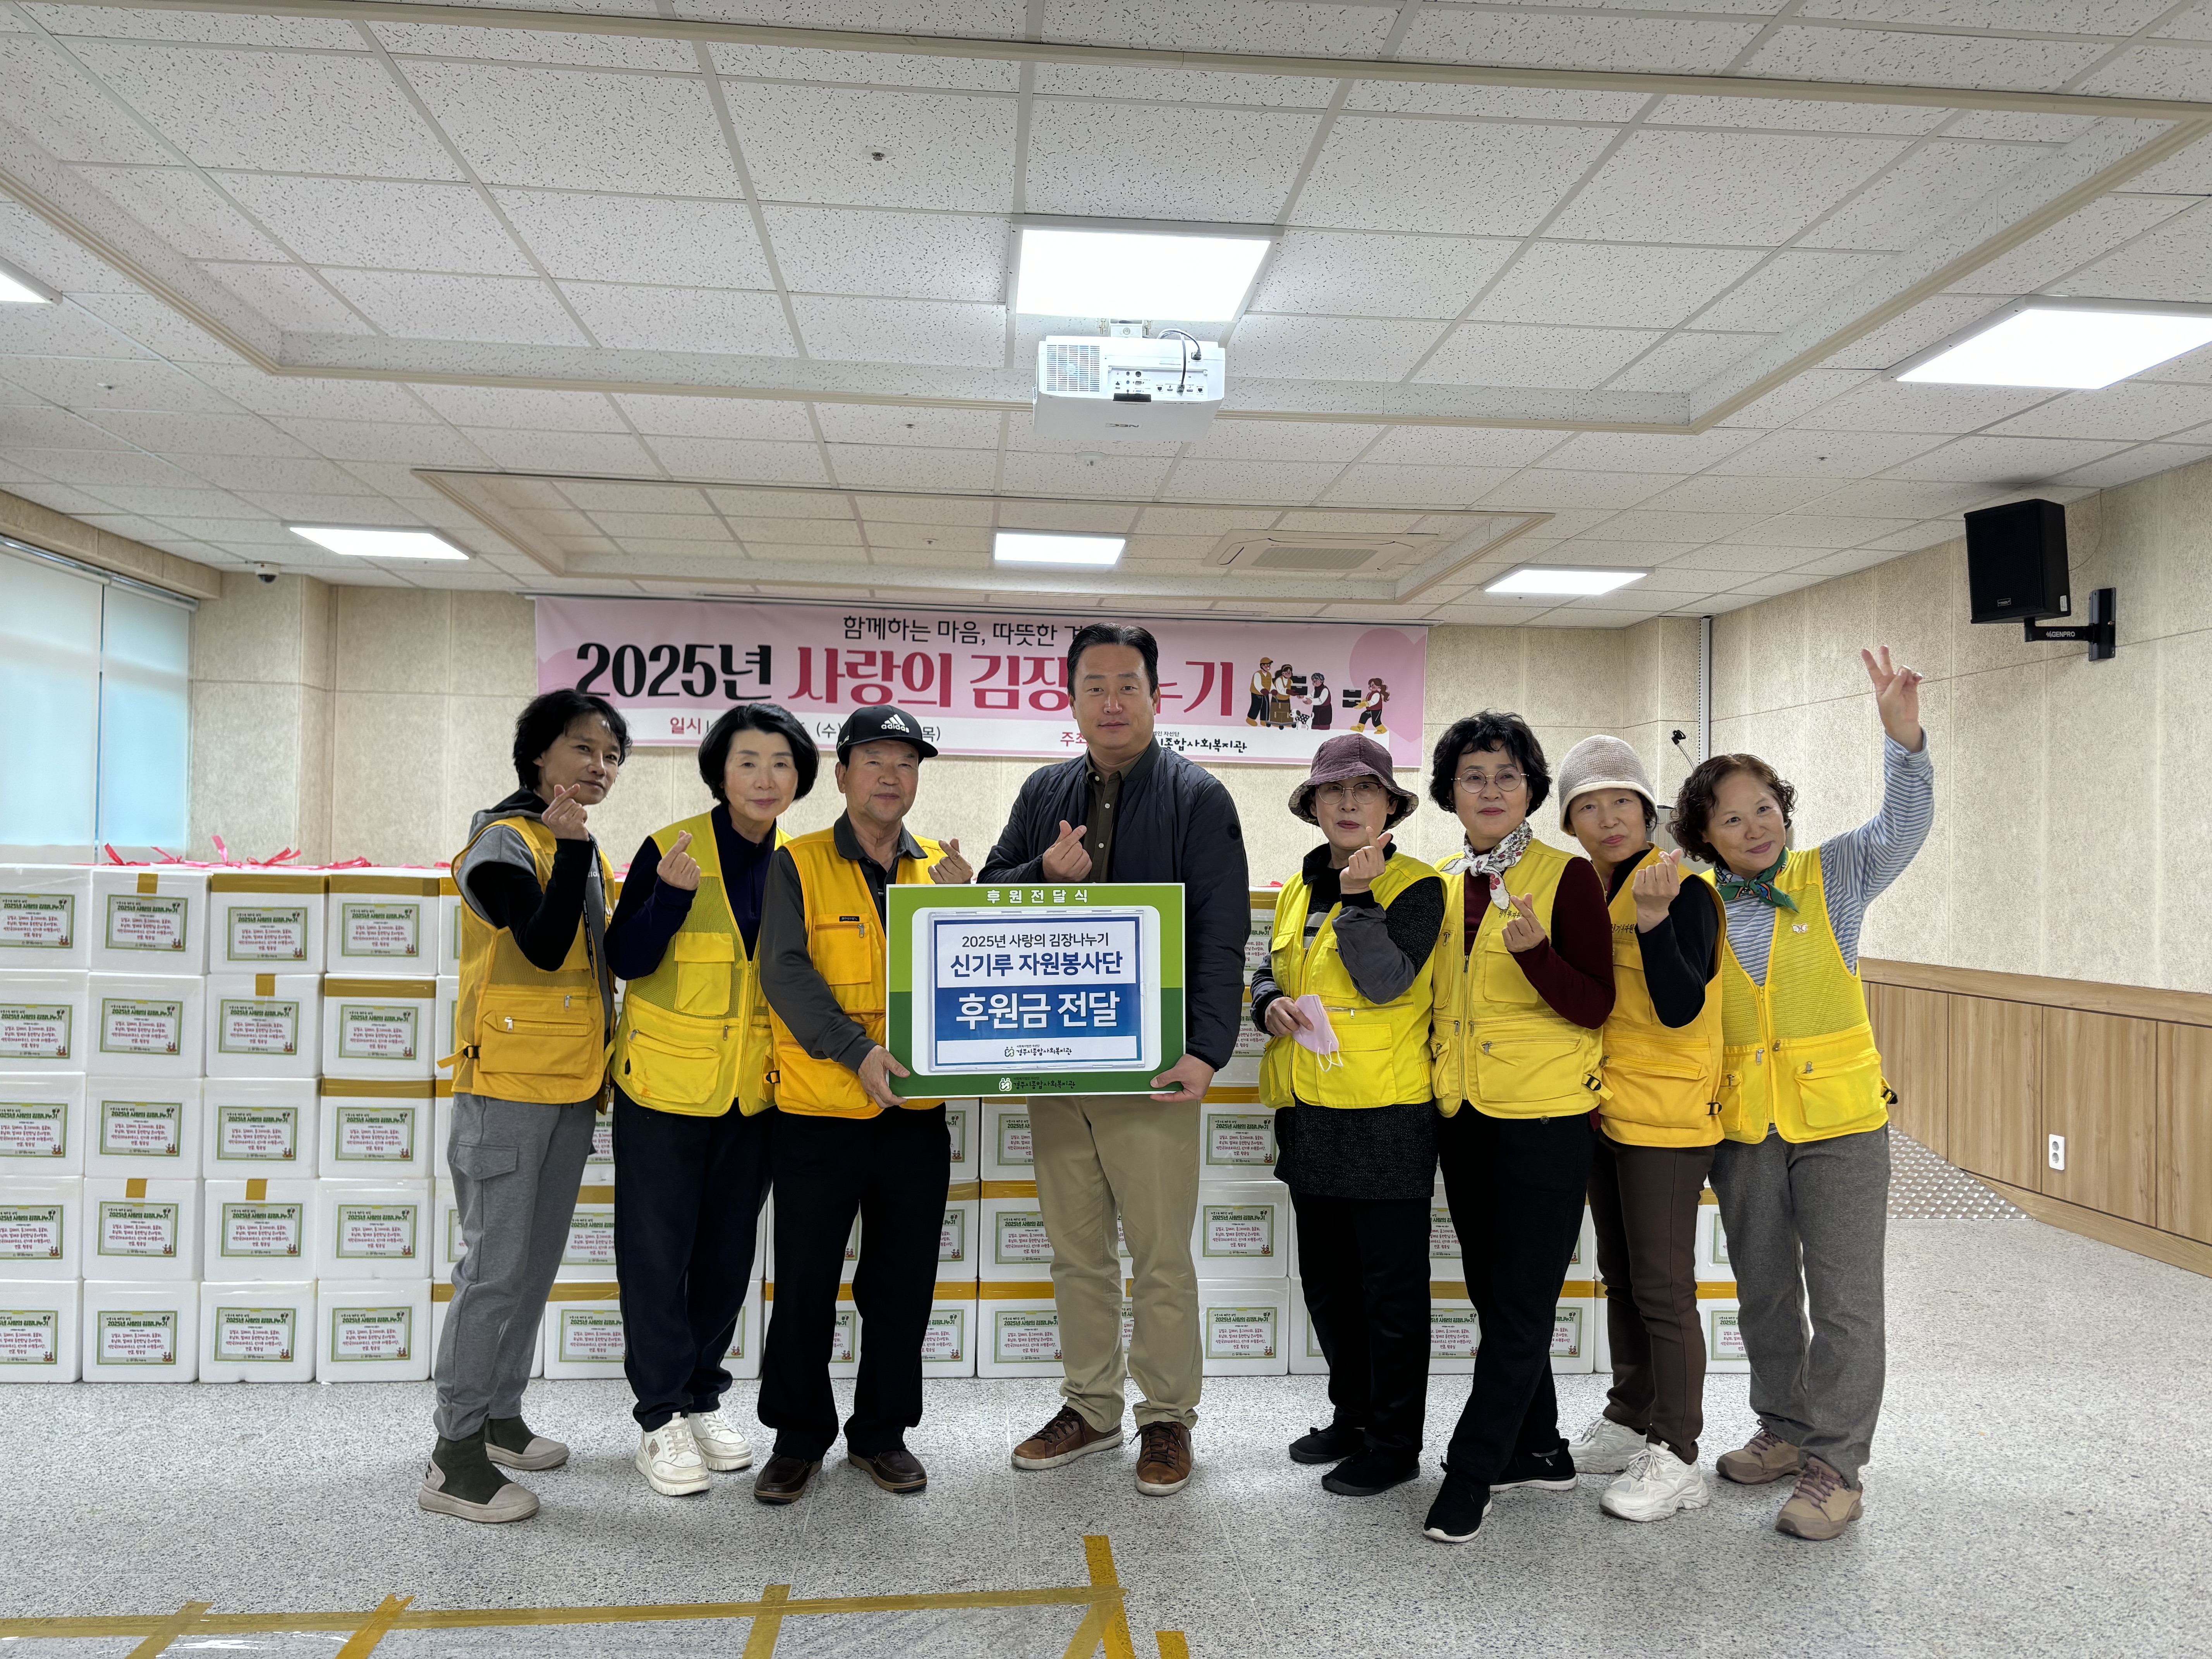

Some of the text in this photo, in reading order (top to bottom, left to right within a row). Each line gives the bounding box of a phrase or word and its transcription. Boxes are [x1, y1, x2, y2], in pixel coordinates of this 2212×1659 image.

[843, 615, 931, 642] 함께하는
[938, 620, 986, 646] 마음,
[993, 623, 1058, 647] 따뜻한
[577, 642, 771, 701] 2025년
[788, 647, 951, 708] 사랑의
[670, 716, 701, 735] 일시
[881, 723, 910, 733] adidas
[962, 932, 1109, 948] 2025년 사랑의 김장나누기
[950, 951, 1123, 978] 신기루 자원봉사단
[956, 990, 1120, 1030] 후원금 전달
[1016, 1047, 1072, 1056] 경주시종합사회복지관
